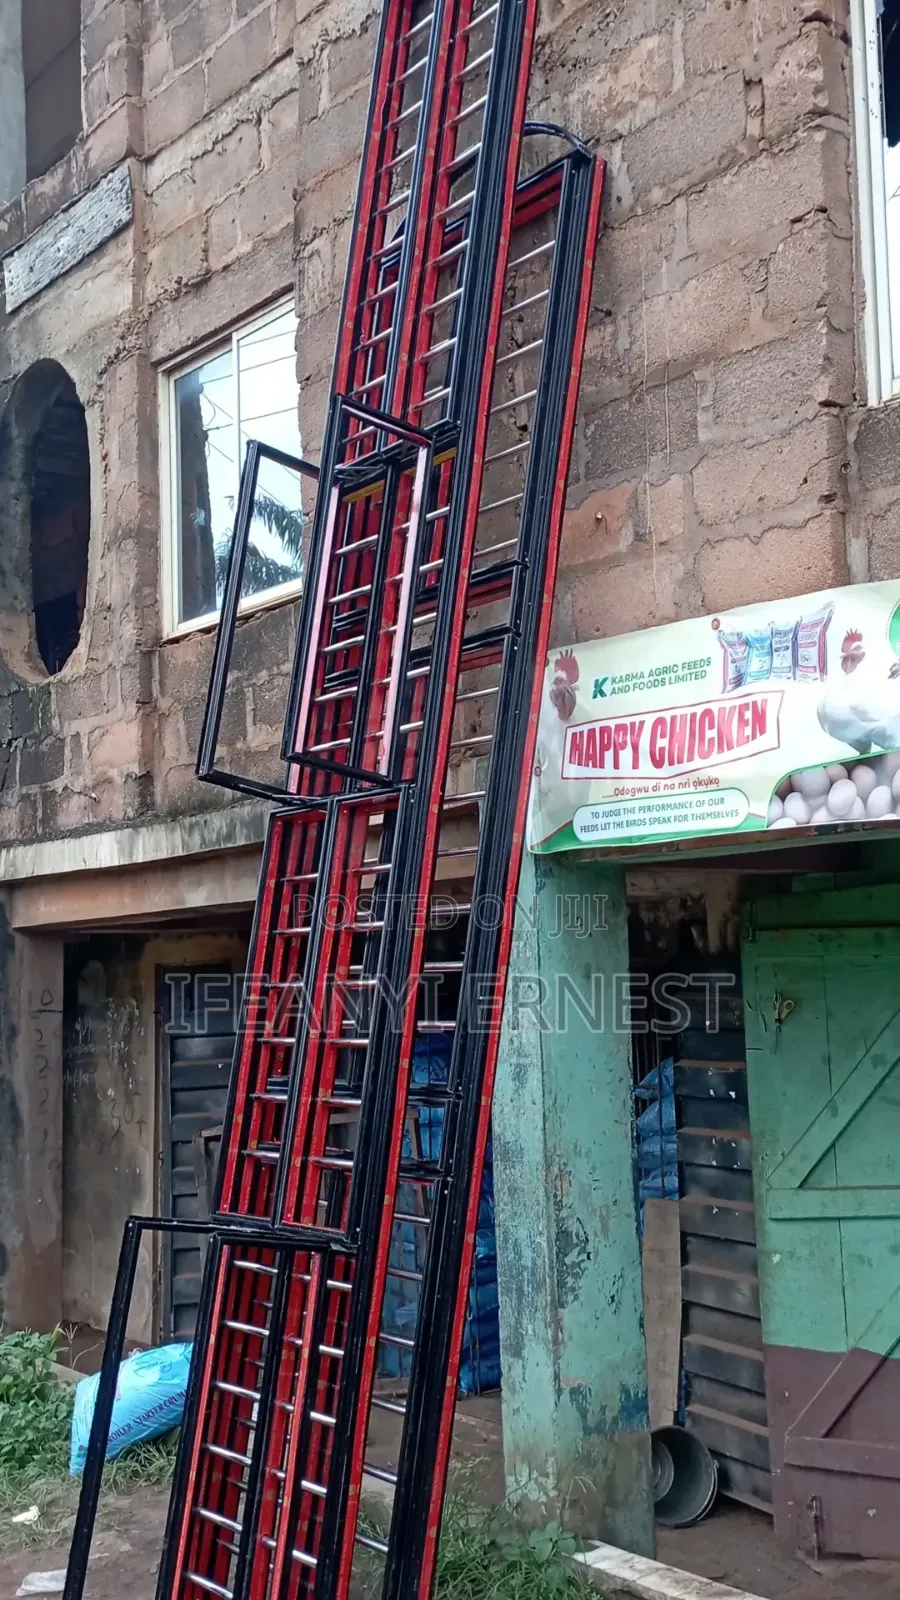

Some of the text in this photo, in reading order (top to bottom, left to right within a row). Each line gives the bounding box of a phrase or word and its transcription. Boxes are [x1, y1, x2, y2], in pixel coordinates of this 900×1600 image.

[610, 670, 707, 696] AND FOODS LIMITED
[611, 657, 712, 685] KARMA AGRIC FEEDS
[569, 699, 768, 770] HAPPY CHICKEN
[663, 782, 676, 791] na
[678, 778, 691, 789] nri
[591, 797, 725, 819] TO JUDGE THE PERFORMANCE OF OUR
[580, 809, 739, 833] FEEDS LET THE BIRDS SPEAK FOR THEMSELVES
